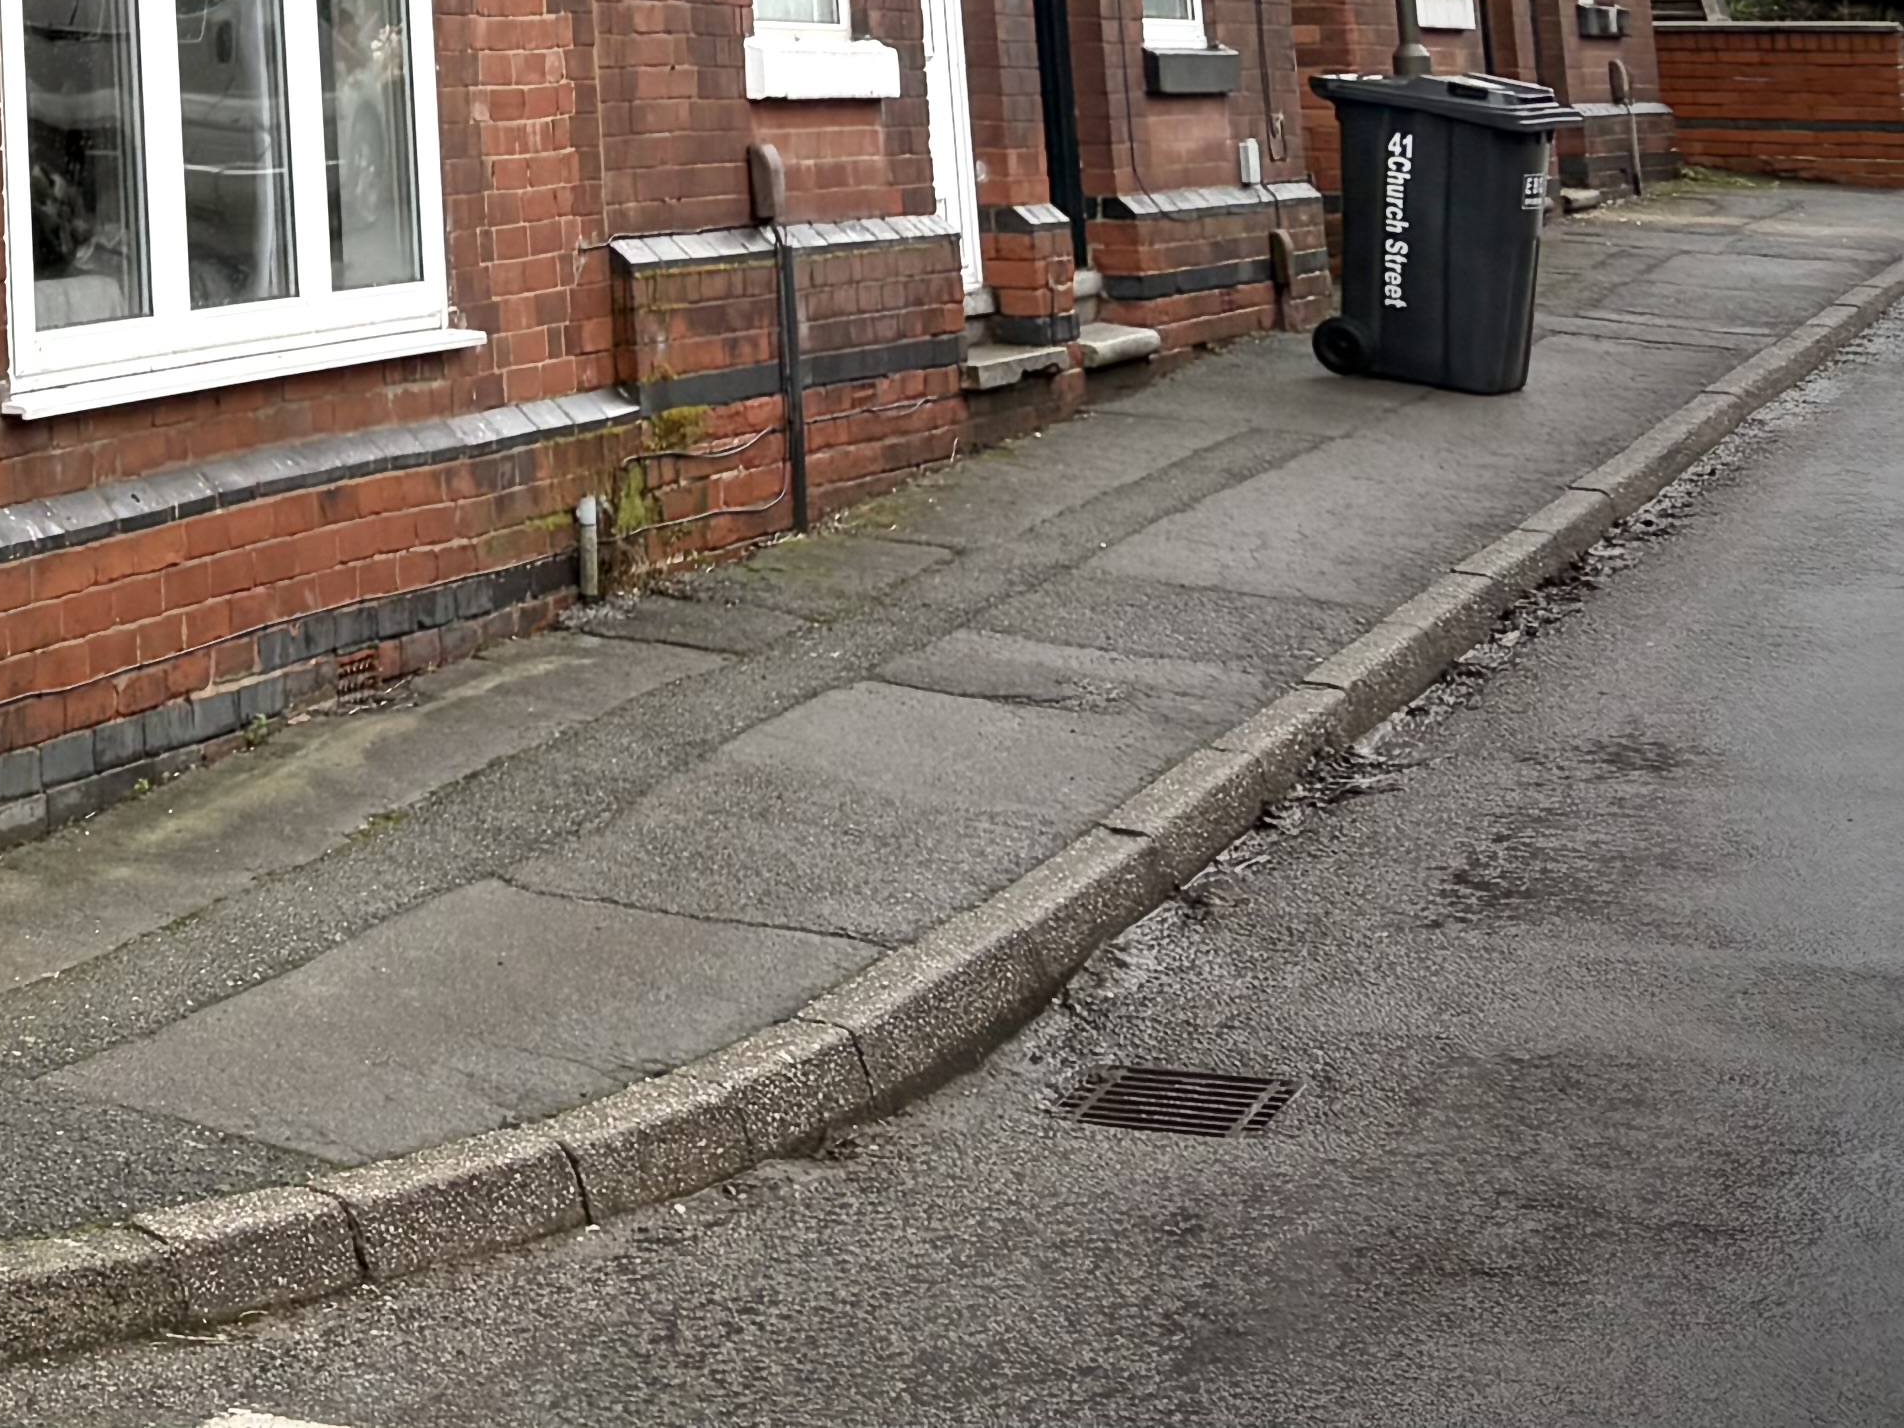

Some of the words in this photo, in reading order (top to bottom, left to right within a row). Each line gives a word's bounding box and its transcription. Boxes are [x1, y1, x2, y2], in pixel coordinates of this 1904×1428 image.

[1387, 132, 1413, 158] 41
[1386, 156, 1412, 233] Church
[1384, 238, 1408, 308] Street
